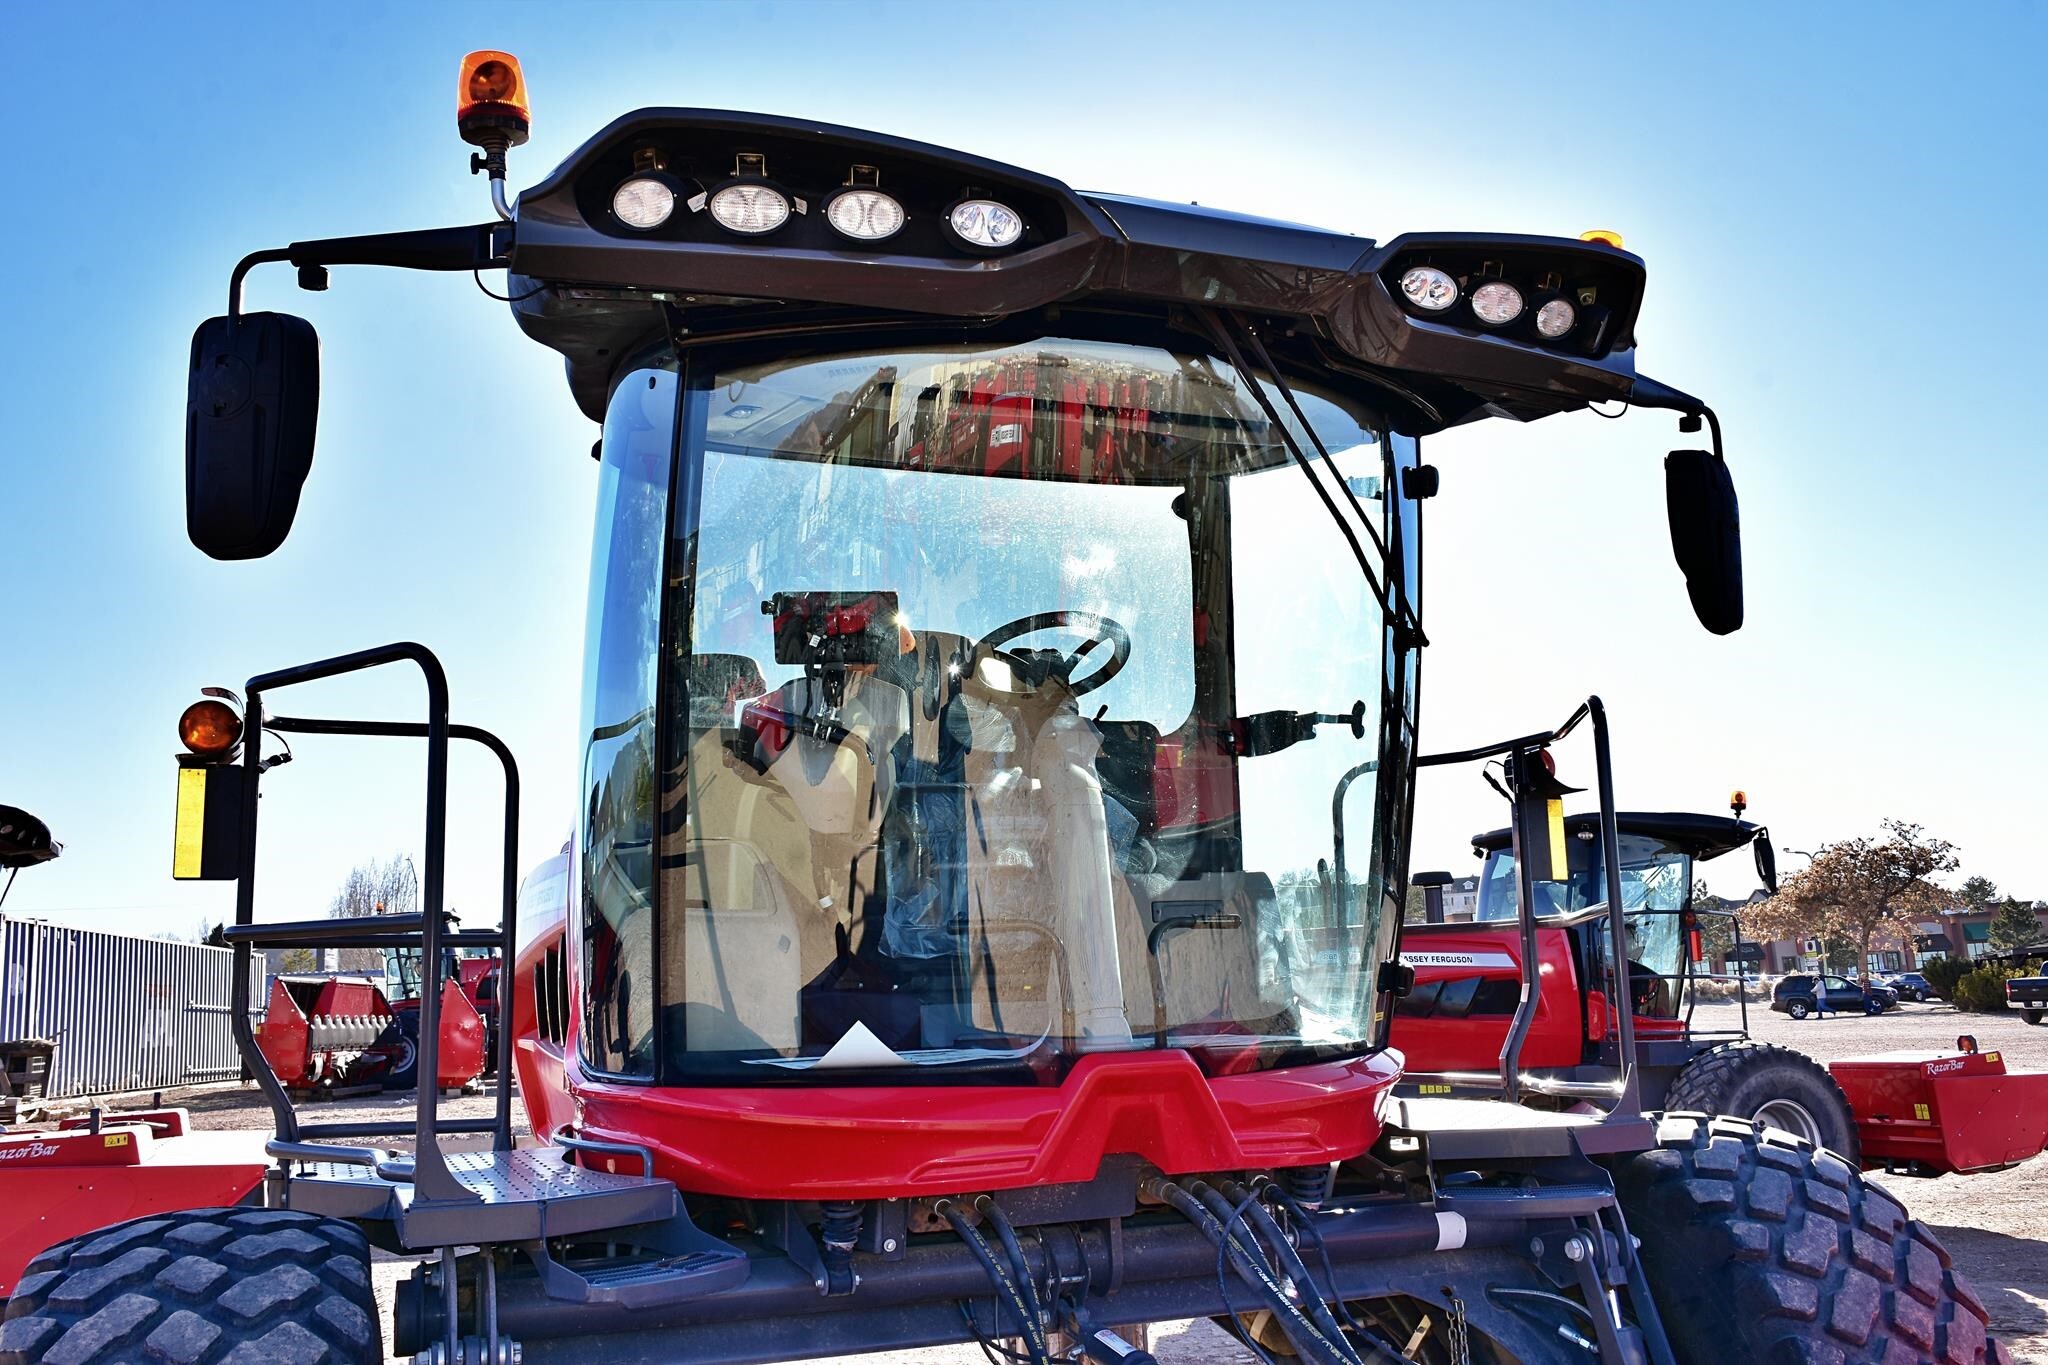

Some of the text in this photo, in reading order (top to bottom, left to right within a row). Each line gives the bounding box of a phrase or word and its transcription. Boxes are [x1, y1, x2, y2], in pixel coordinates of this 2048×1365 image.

[1400, 955, 1429, 963] ASSEY
[1925, 1060, 1964, 1075] RazorBar
[0, 1142, 60, 1161] azorBar
